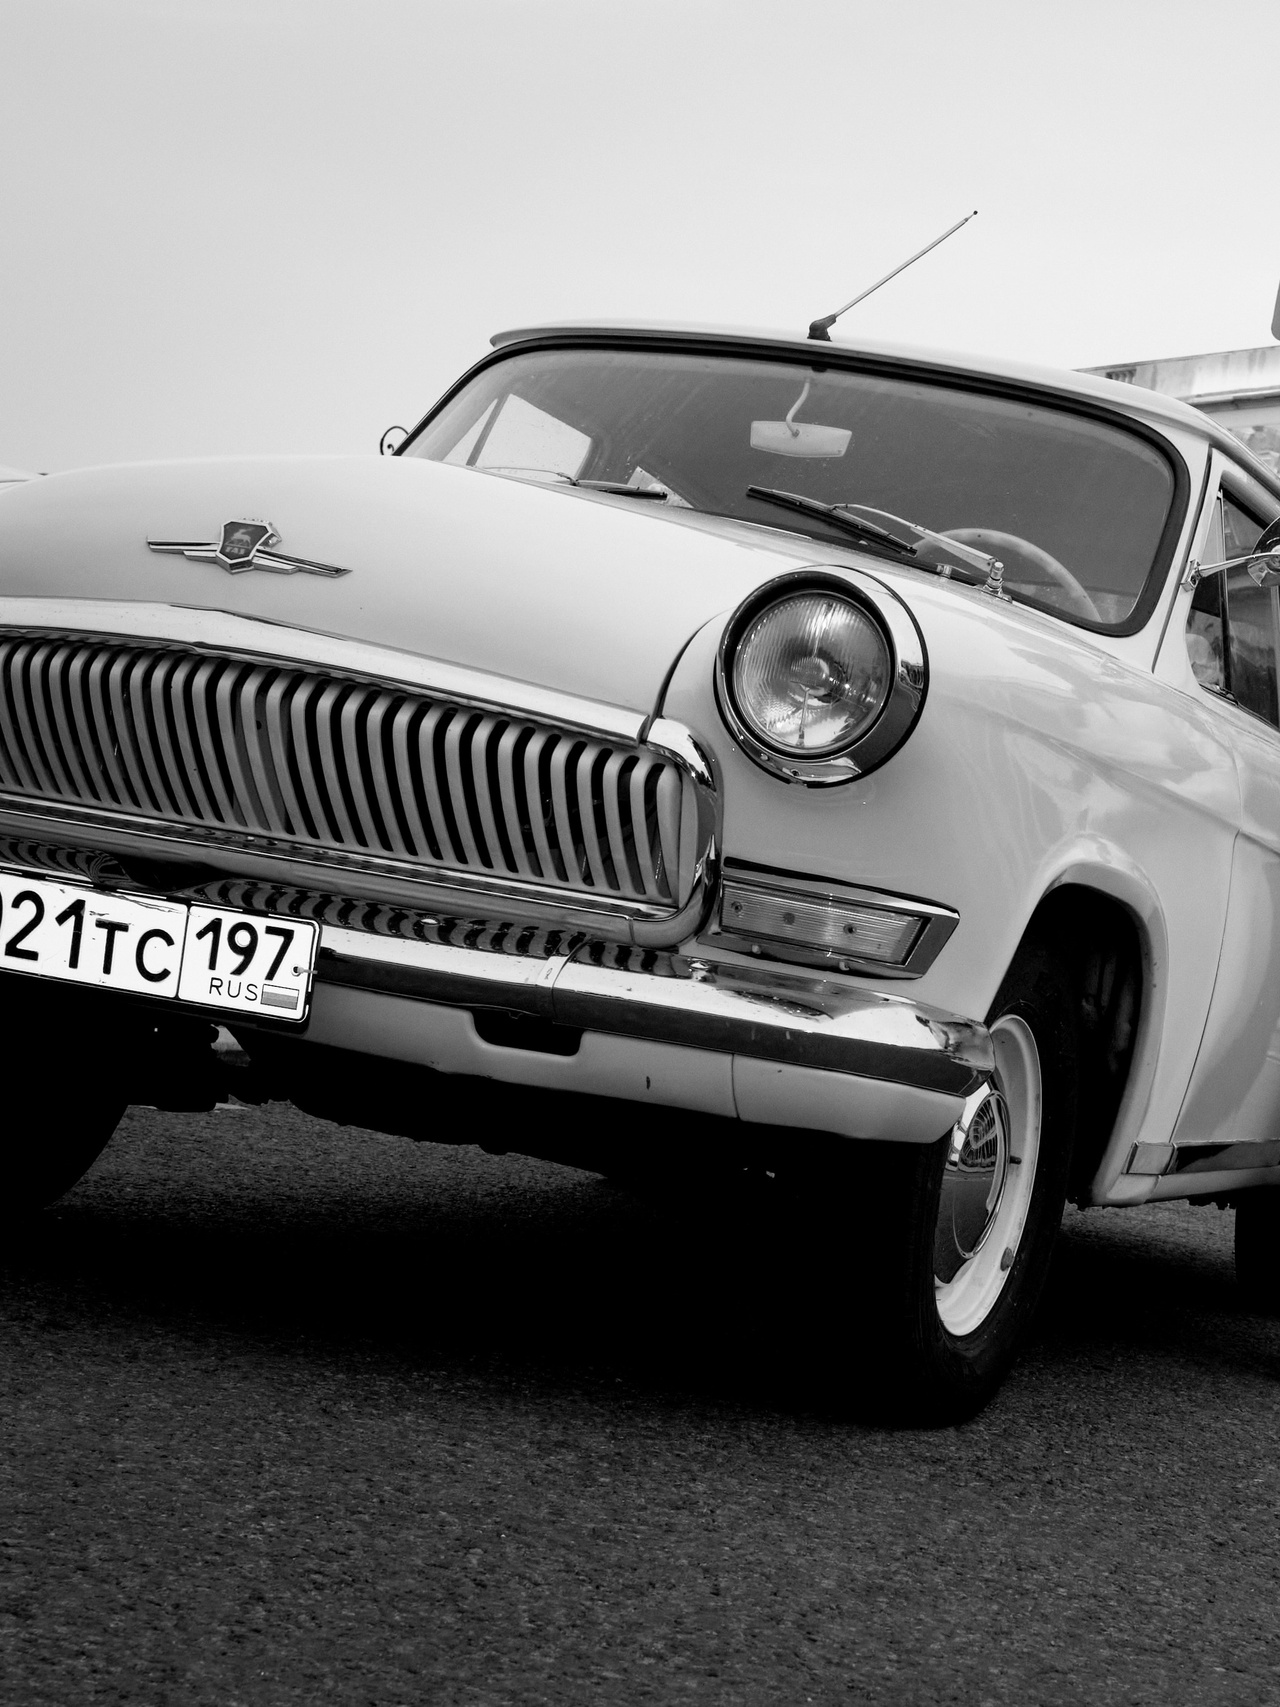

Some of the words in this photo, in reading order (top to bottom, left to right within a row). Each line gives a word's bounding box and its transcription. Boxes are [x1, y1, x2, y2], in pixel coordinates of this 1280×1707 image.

[0, 890, 175, 982] 21TC
[195, 918, 295, 980] 197
[209, 977, 258, 1001] RUS
